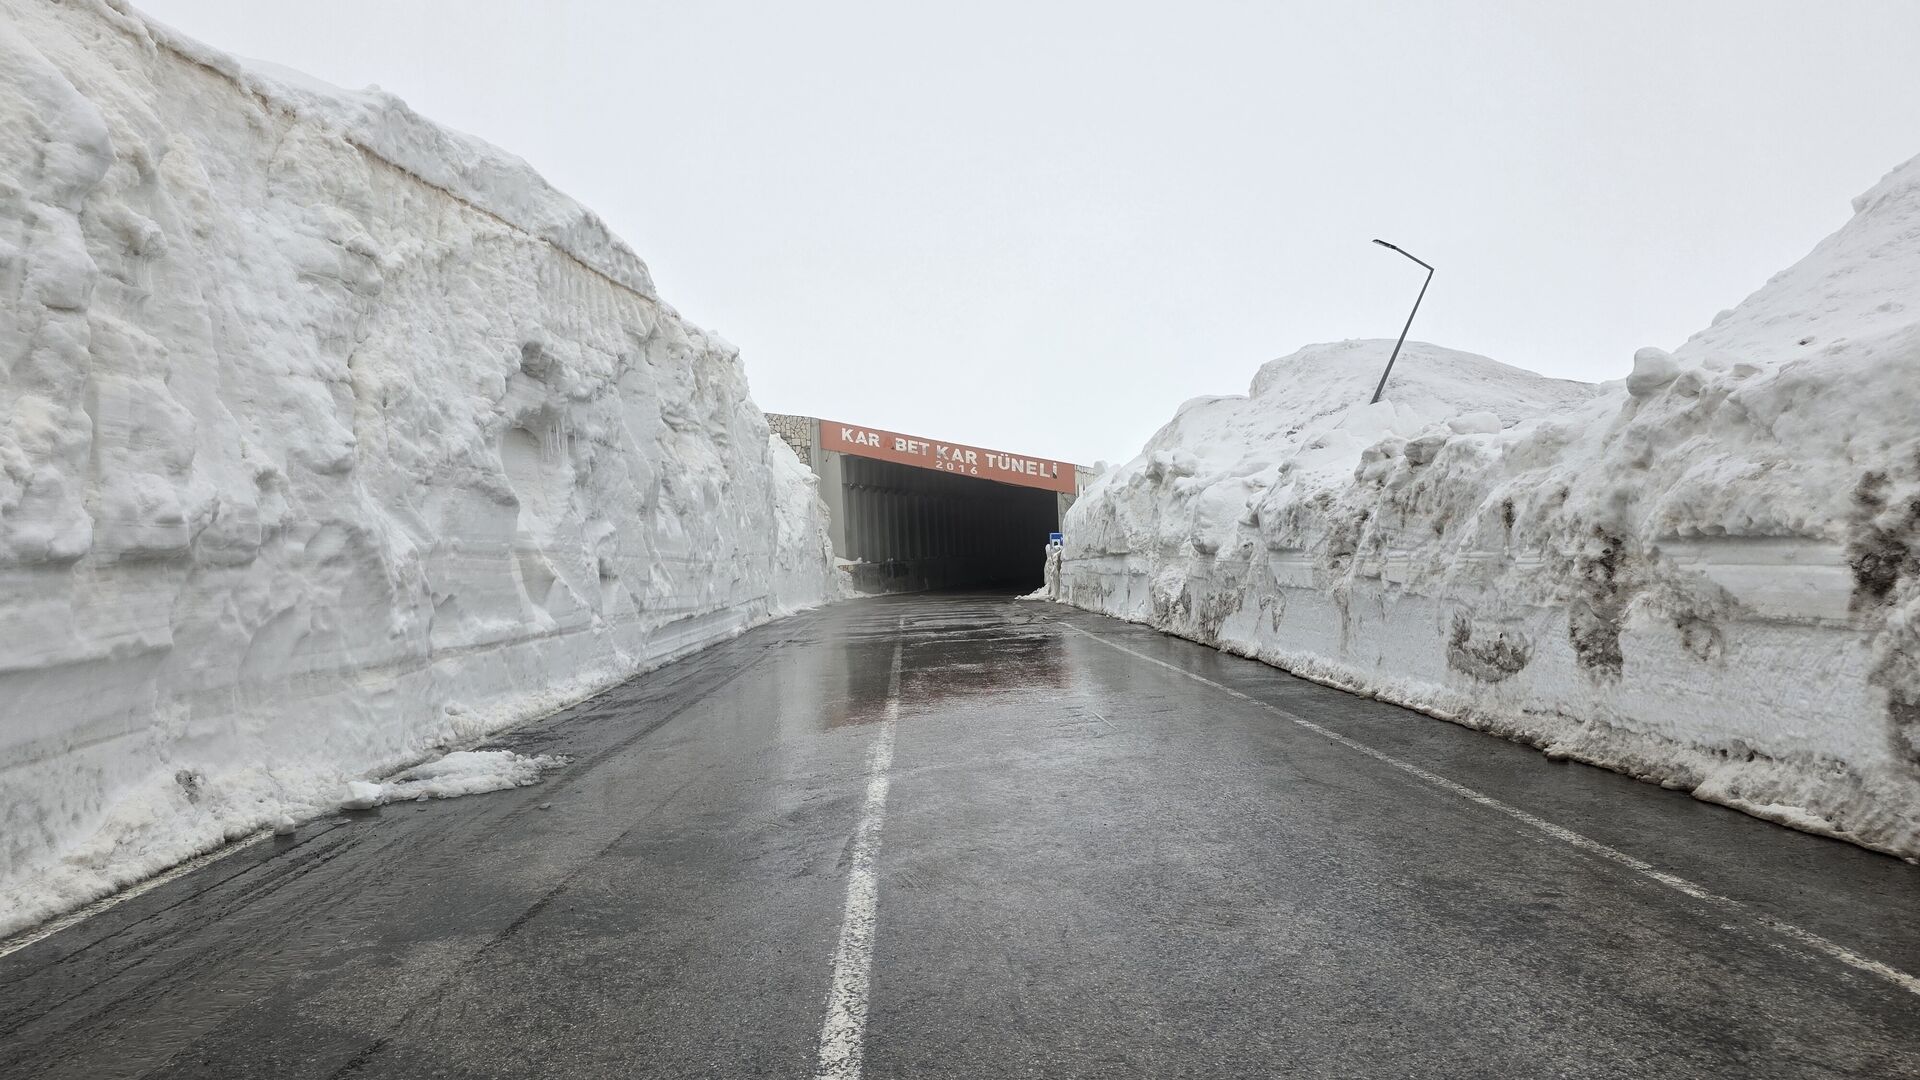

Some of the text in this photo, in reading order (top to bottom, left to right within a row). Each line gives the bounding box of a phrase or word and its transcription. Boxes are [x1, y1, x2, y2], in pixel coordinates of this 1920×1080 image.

[935, 460, 978, 475] 2016
[936, 444, 978, 466] KAR
[985, 453, 1058, 479] TÜNELİ
